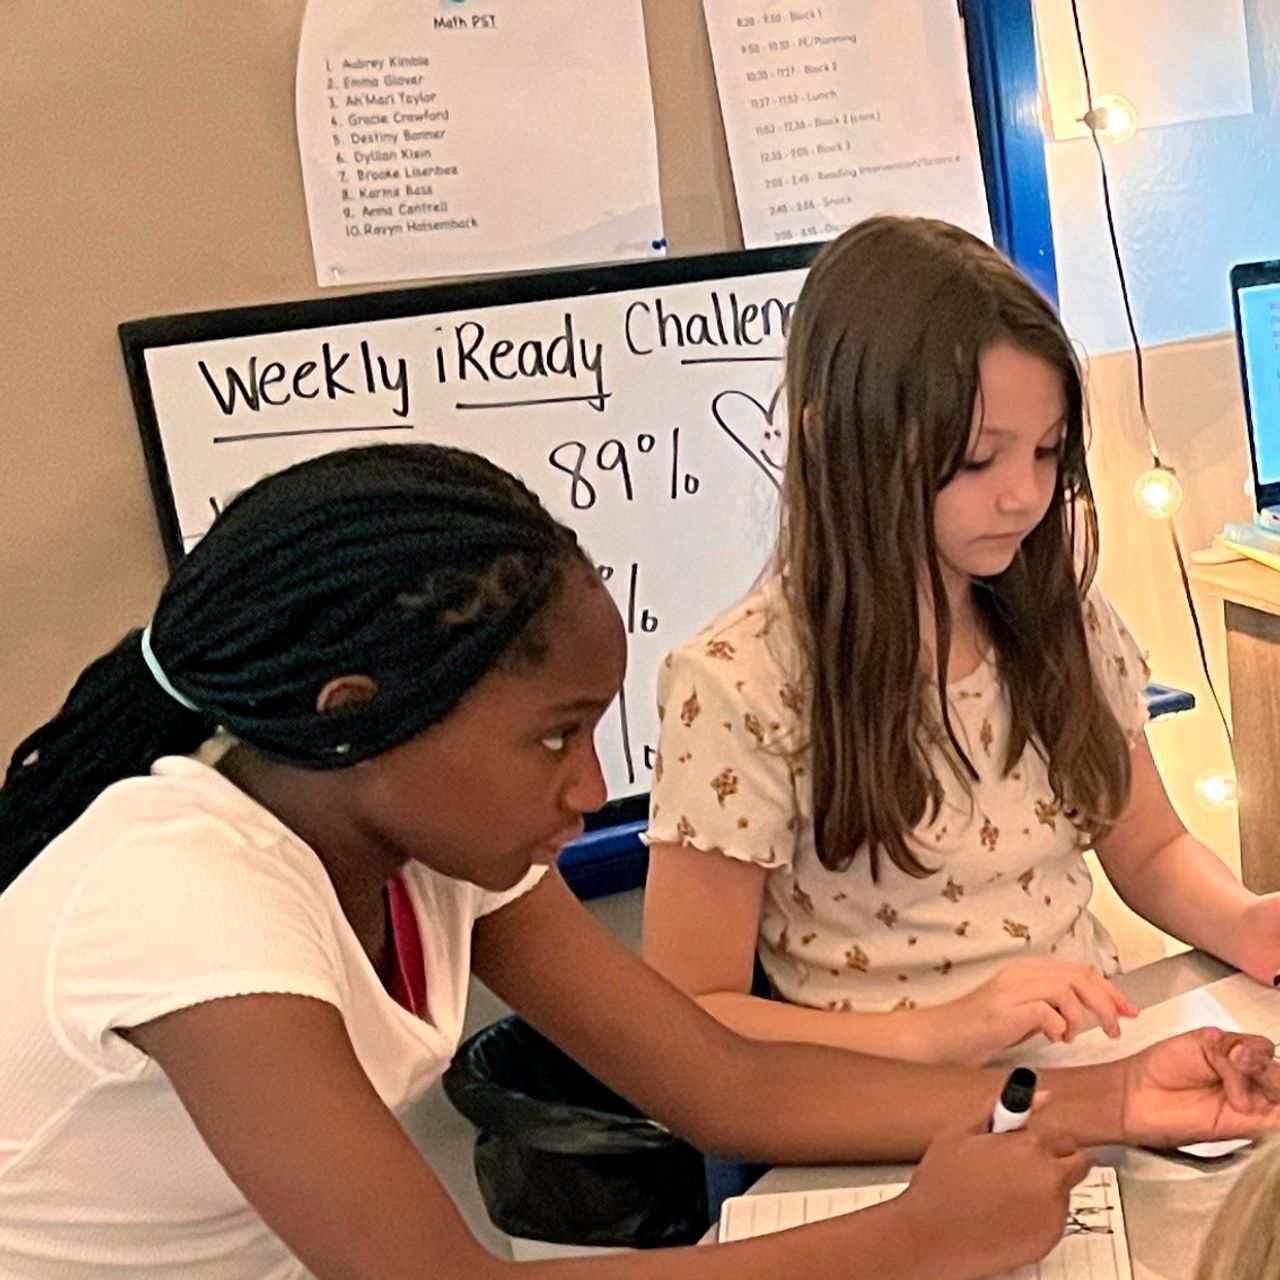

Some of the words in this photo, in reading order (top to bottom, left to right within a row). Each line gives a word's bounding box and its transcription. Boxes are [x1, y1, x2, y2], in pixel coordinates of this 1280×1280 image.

[433, 15, 468, 29] Math
[472, 14, 497, 29] PST
[343, 77, 379, 89] Emma
[400, 91, 437, 107] Taylor
[807, 90, 837, 102] Lunch
[351, 131, 398, 145] Destiny
[357, 169, 400, 181] Brooke
[199, 341, 411, 418] Weekly
[434, 313, 607, 412] iReady
[549, 427, 700, 510] 89%
